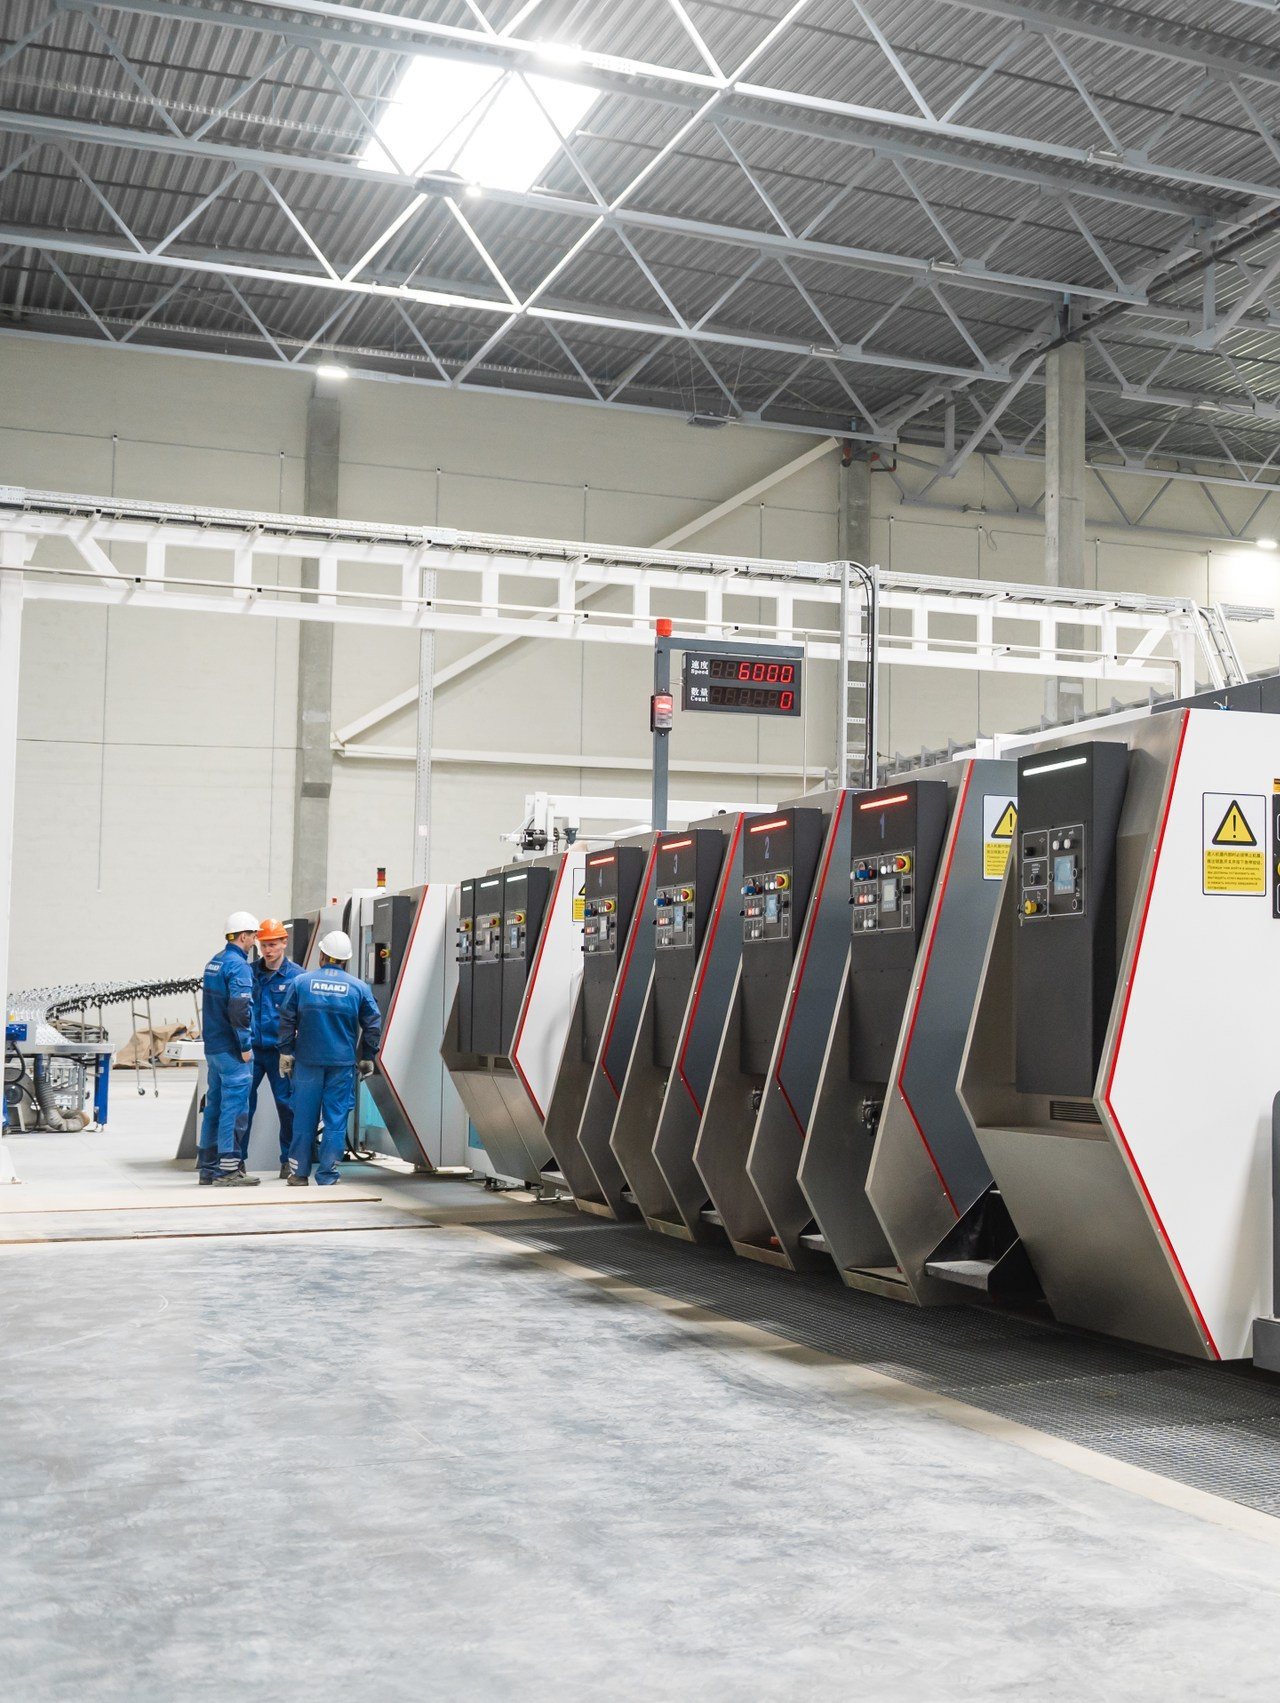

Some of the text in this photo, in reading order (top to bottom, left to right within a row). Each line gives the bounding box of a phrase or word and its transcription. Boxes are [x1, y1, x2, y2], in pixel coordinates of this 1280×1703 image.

[738, 662, 793, 683] 6000
[780, 691, 792, 709] 0
[880, 812, 886, 839] 1
[764, 836, 770, 860] 2
[672, 854, 678, 874] 3
